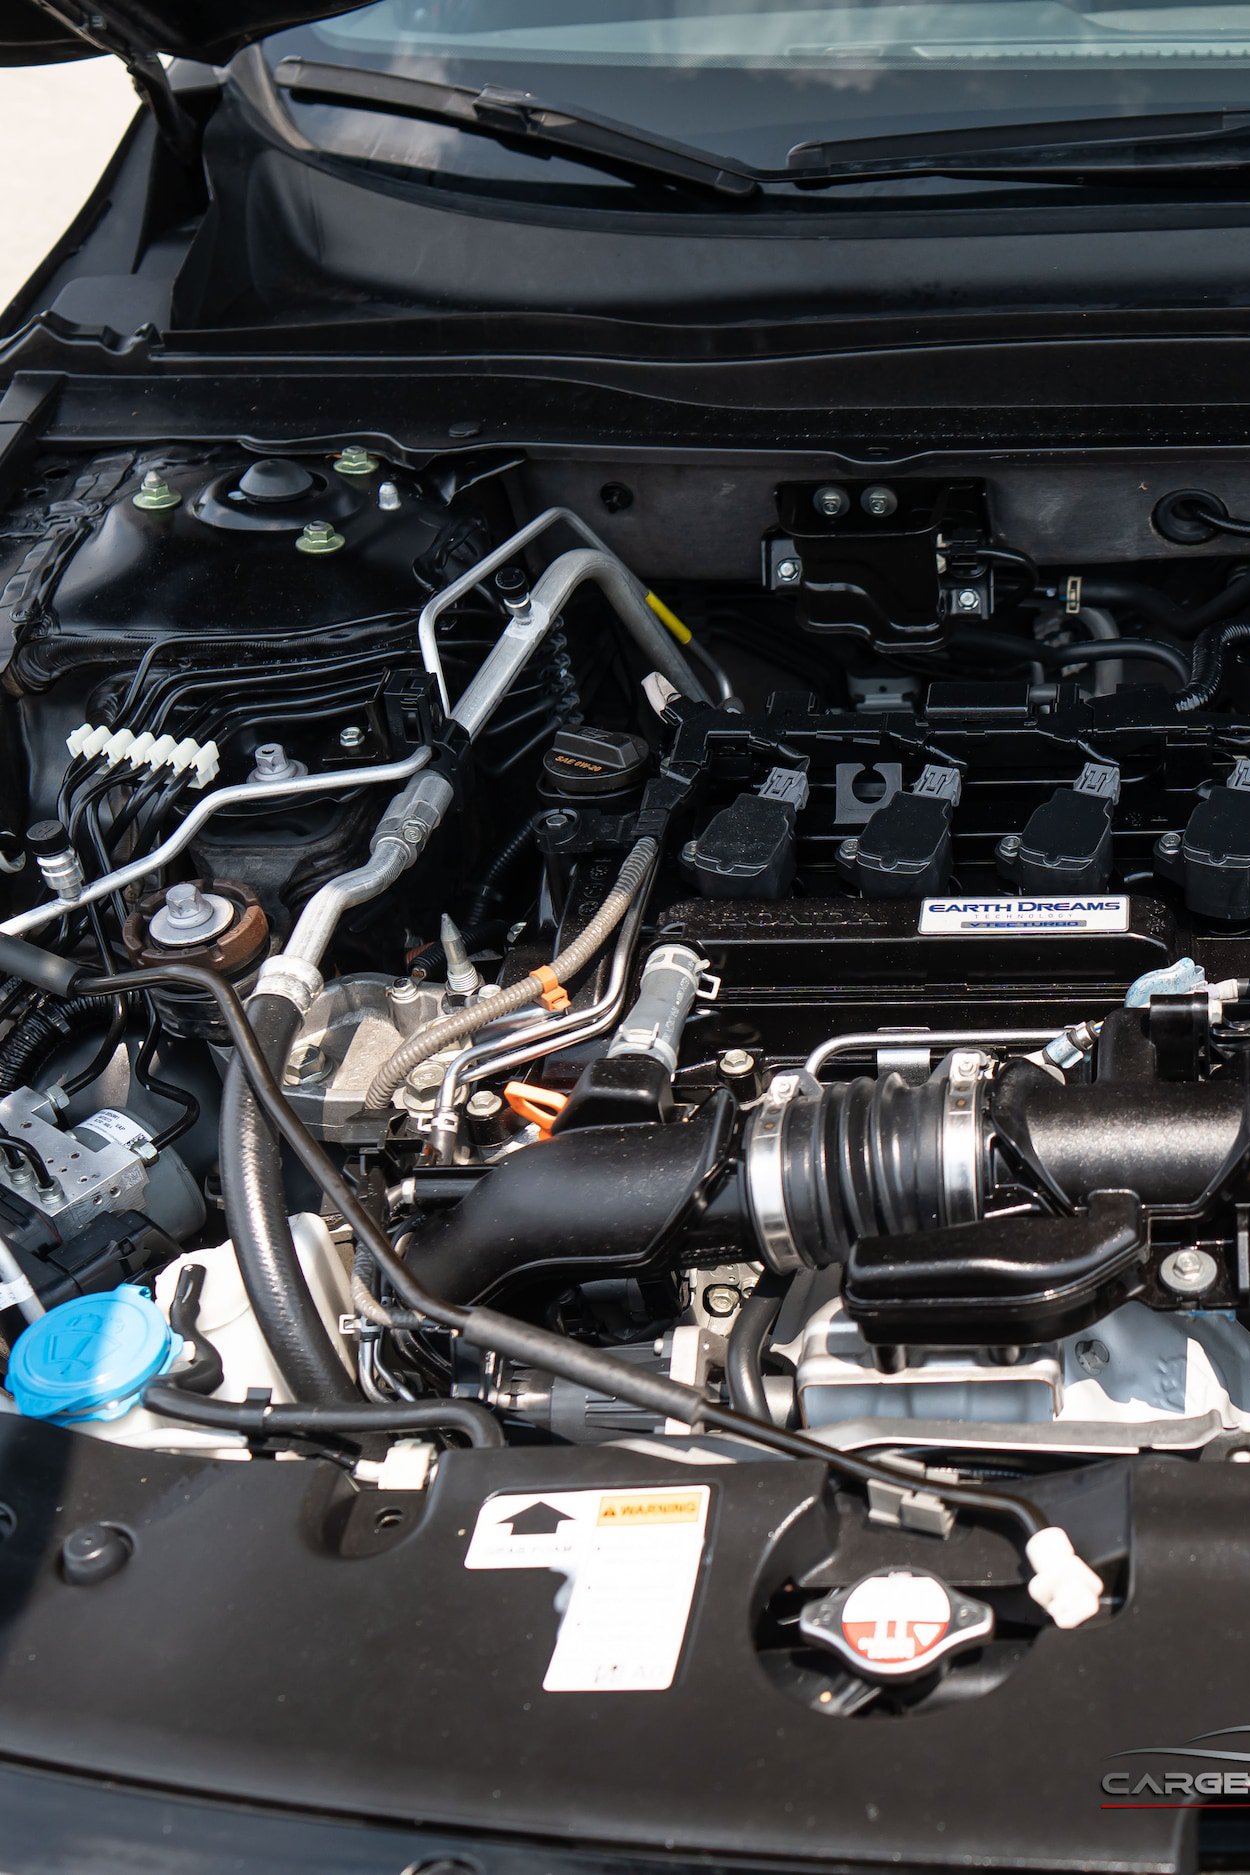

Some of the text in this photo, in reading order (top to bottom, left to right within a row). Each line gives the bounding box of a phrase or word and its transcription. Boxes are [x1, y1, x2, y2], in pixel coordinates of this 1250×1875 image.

[929, 901, 1121, 913] EARTH DREAMS
[621, 1503, 696, 1516] WARNING
